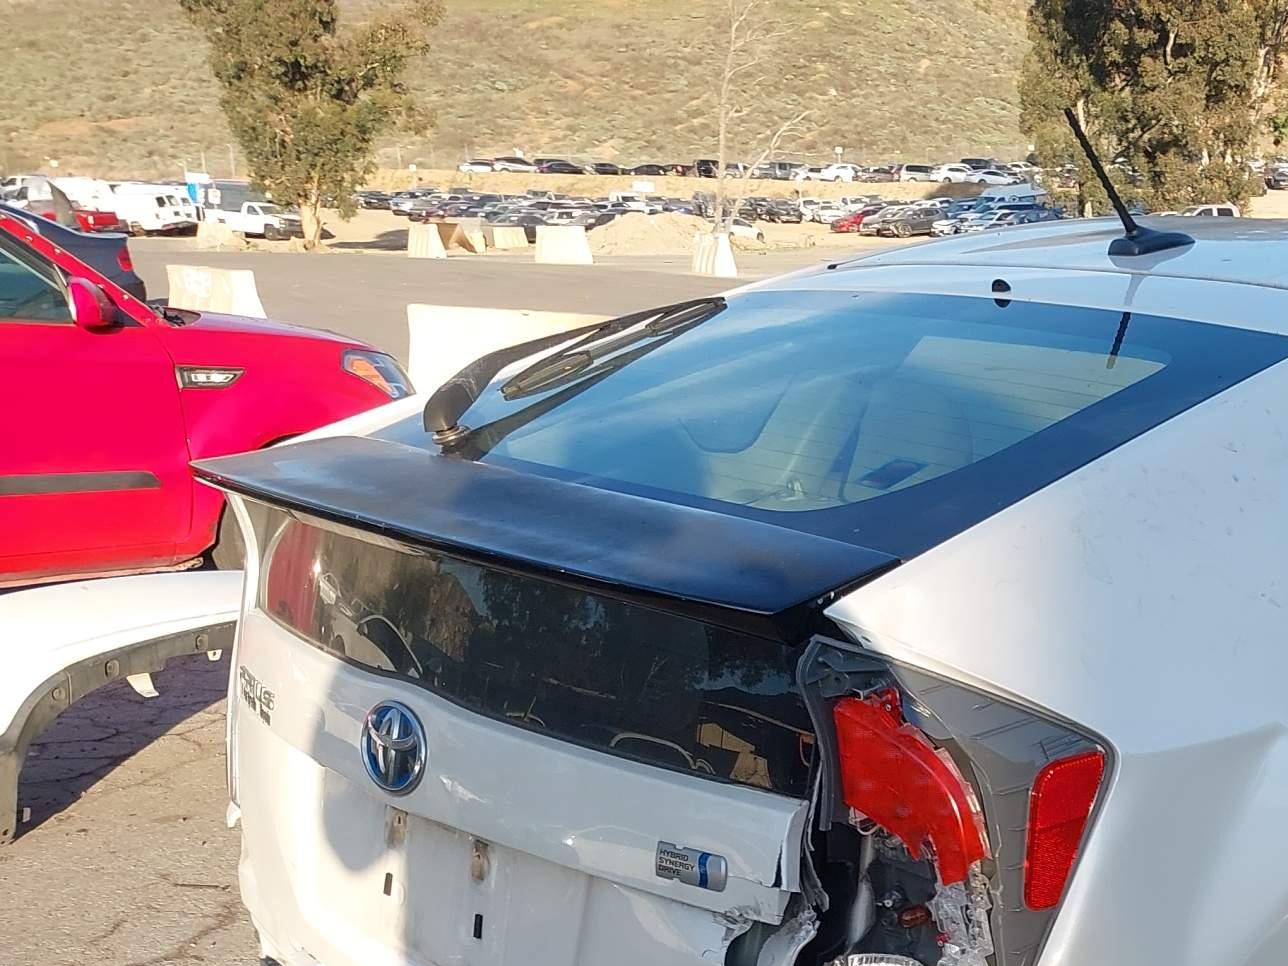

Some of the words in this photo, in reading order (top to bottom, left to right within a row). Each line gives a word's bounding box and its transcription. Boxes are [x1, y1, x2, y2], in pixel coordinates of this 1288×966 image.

[659, 849, 689, 862] HYBRID
[658, 856, 695, 871] SYNERGY
[658, 864, 681, 876] DRIVE
